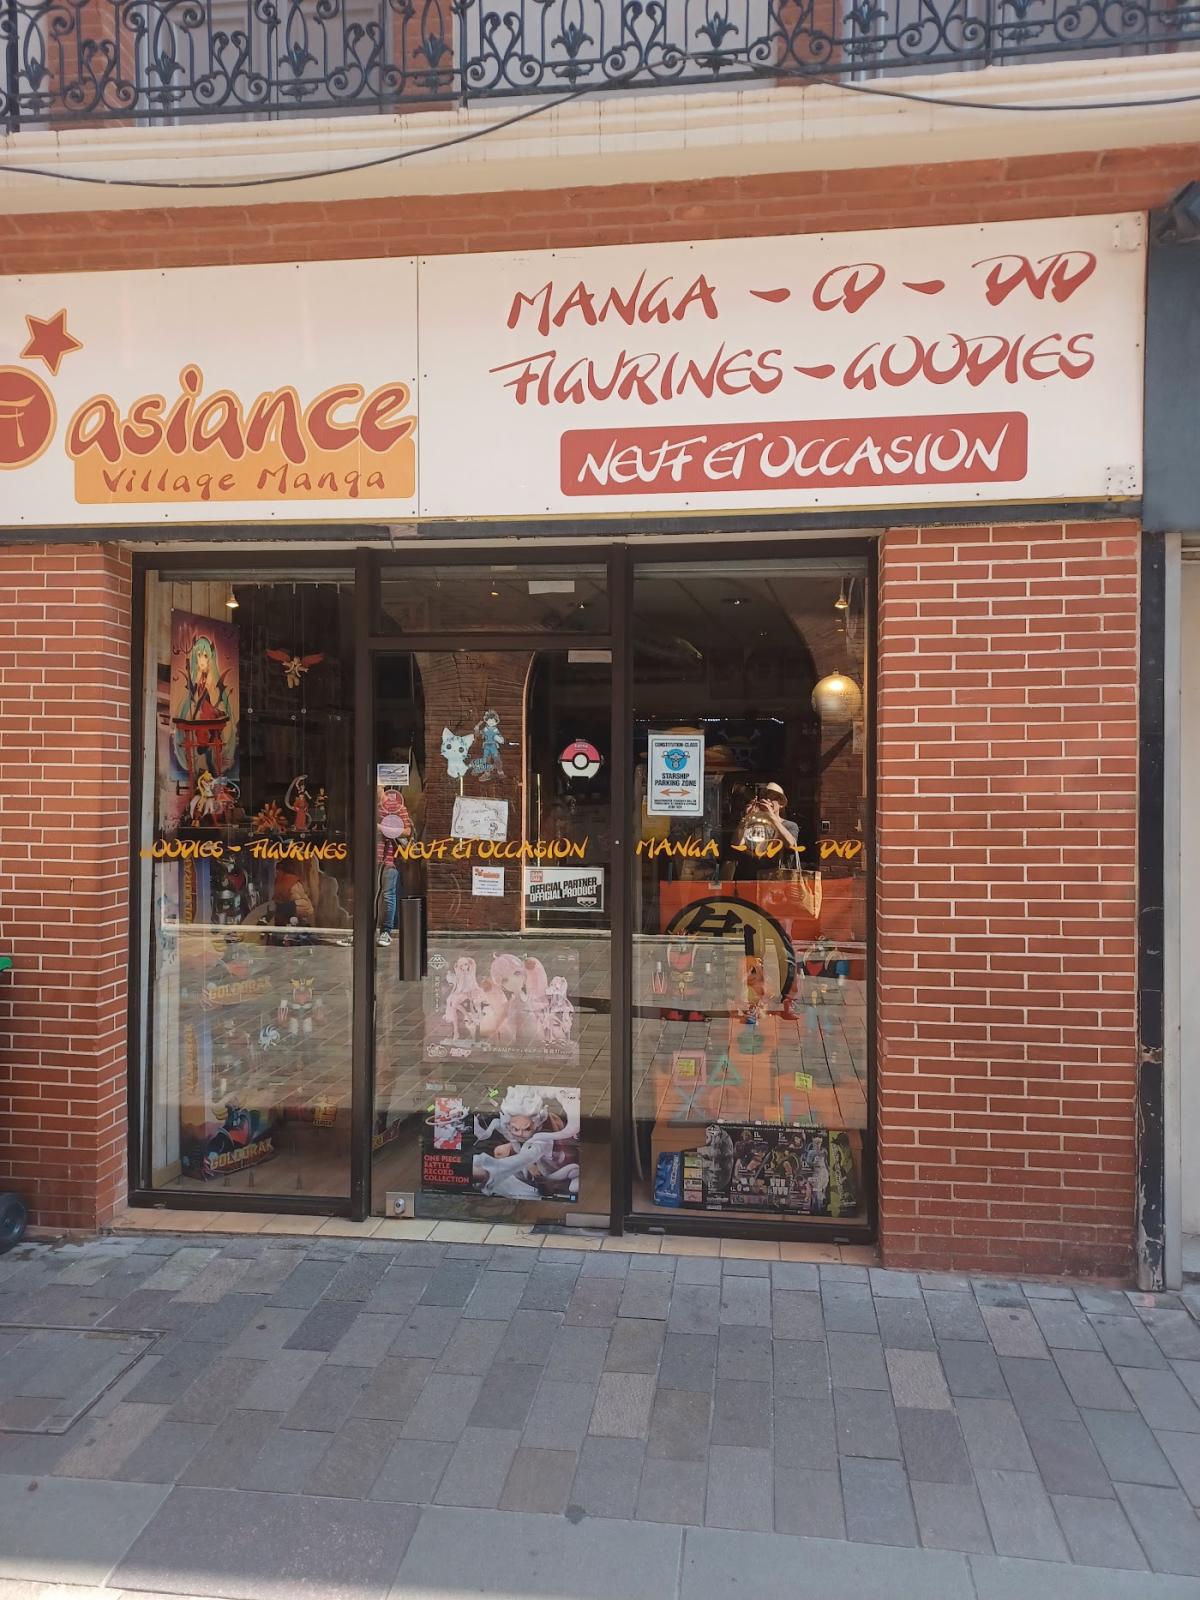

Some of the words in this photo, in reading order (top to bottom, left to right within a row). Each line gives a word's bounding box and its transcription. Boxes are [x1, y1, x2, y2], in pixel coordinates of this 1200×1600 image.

[507, 268, 718, 336] MANGA
[812, 262, 886, 313] CD
[971, 250, 1097, 306] DVD
[489, 341, 783, 405] FIGURINES
[843, 332, 1095, 390] GOODIES
[68, 364, 415, 464] asiance
[577, 434, 708, 486] NEUF
[703, 432, 764, 480] ET
[759, 422, 1009, 478] OCCASION
[102, 468, 236, 499] Village
[256, 463, 385, 498] Manga
[244, 838, 348, 860] FIGURINES
[394, 838, 453, 859] NEUF
[452, 835, 480, 859] ET
[477, 836, 589, 859] OCCASION
[635, 836, 720, 859] MANGA
[815, 838, 863, 860] DVD
[530, 882, 561, 893] OFFICIAL
[563, 877, 597, 889] PARTNER
[530, 890, 561, 902] OFFICIAL
[562, 885, 597, 898] PRODUCT
[424, 1175, 469, 1183] COLLECTION
